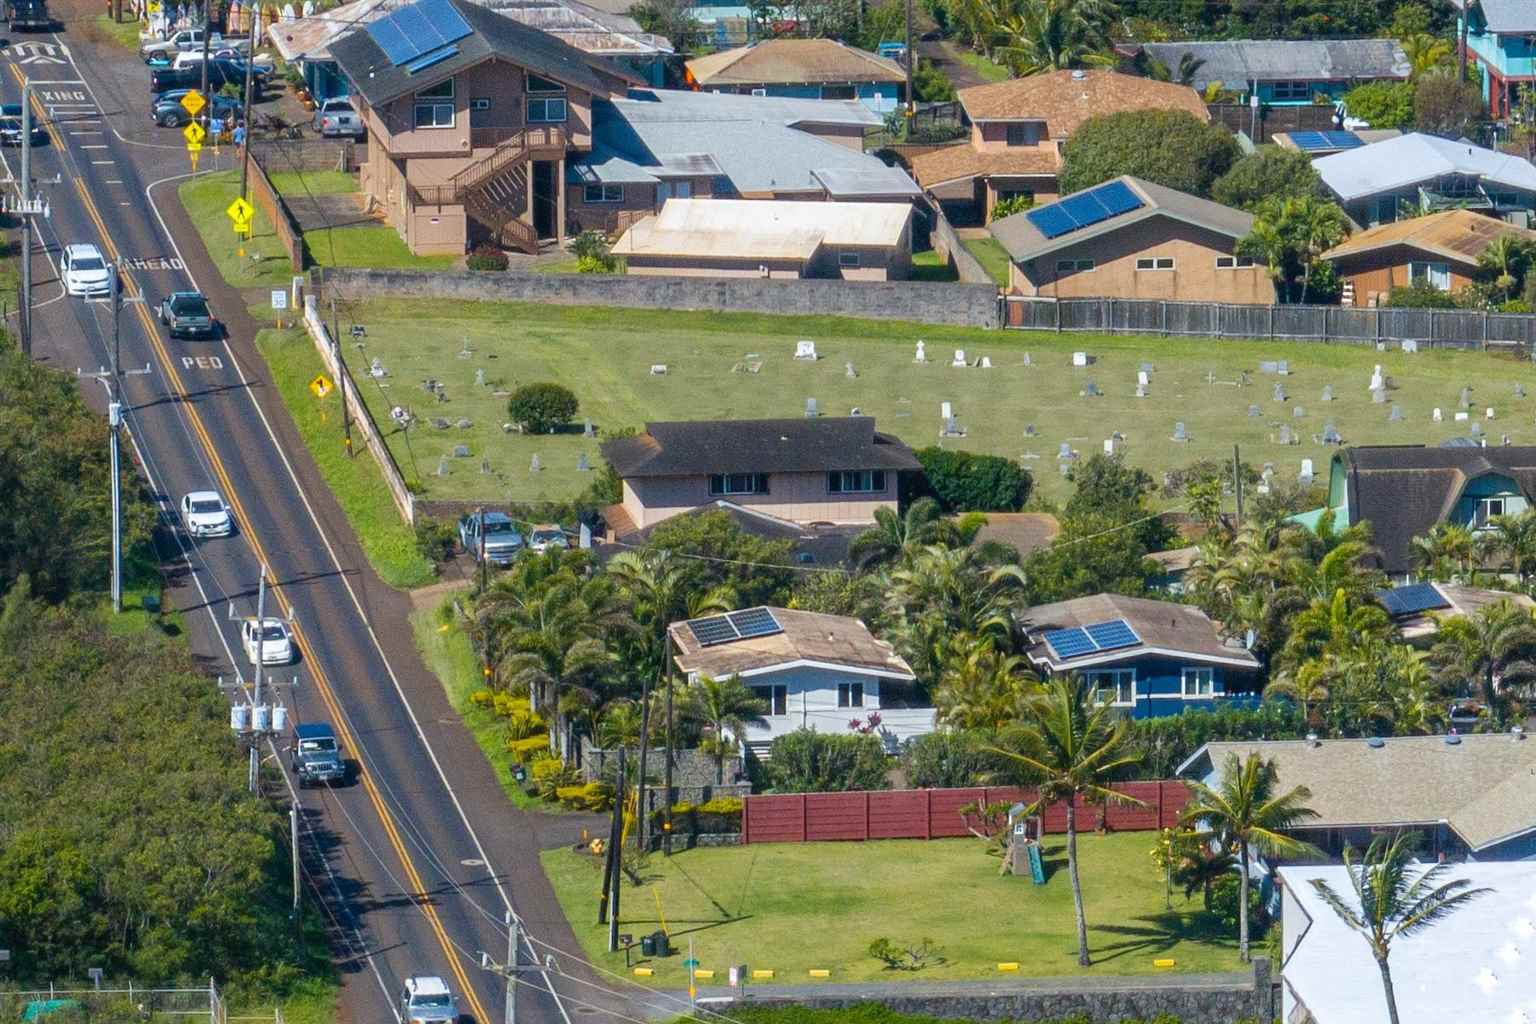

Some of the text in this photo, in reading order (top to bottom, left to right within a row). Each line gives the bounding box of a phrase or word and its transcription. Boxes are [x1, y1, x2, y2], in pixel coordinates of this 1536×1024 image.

[42, 91, 85, 101] XING
[123, 258, 183, 270] AHEAD
[182, 357, 223, 369] PED
